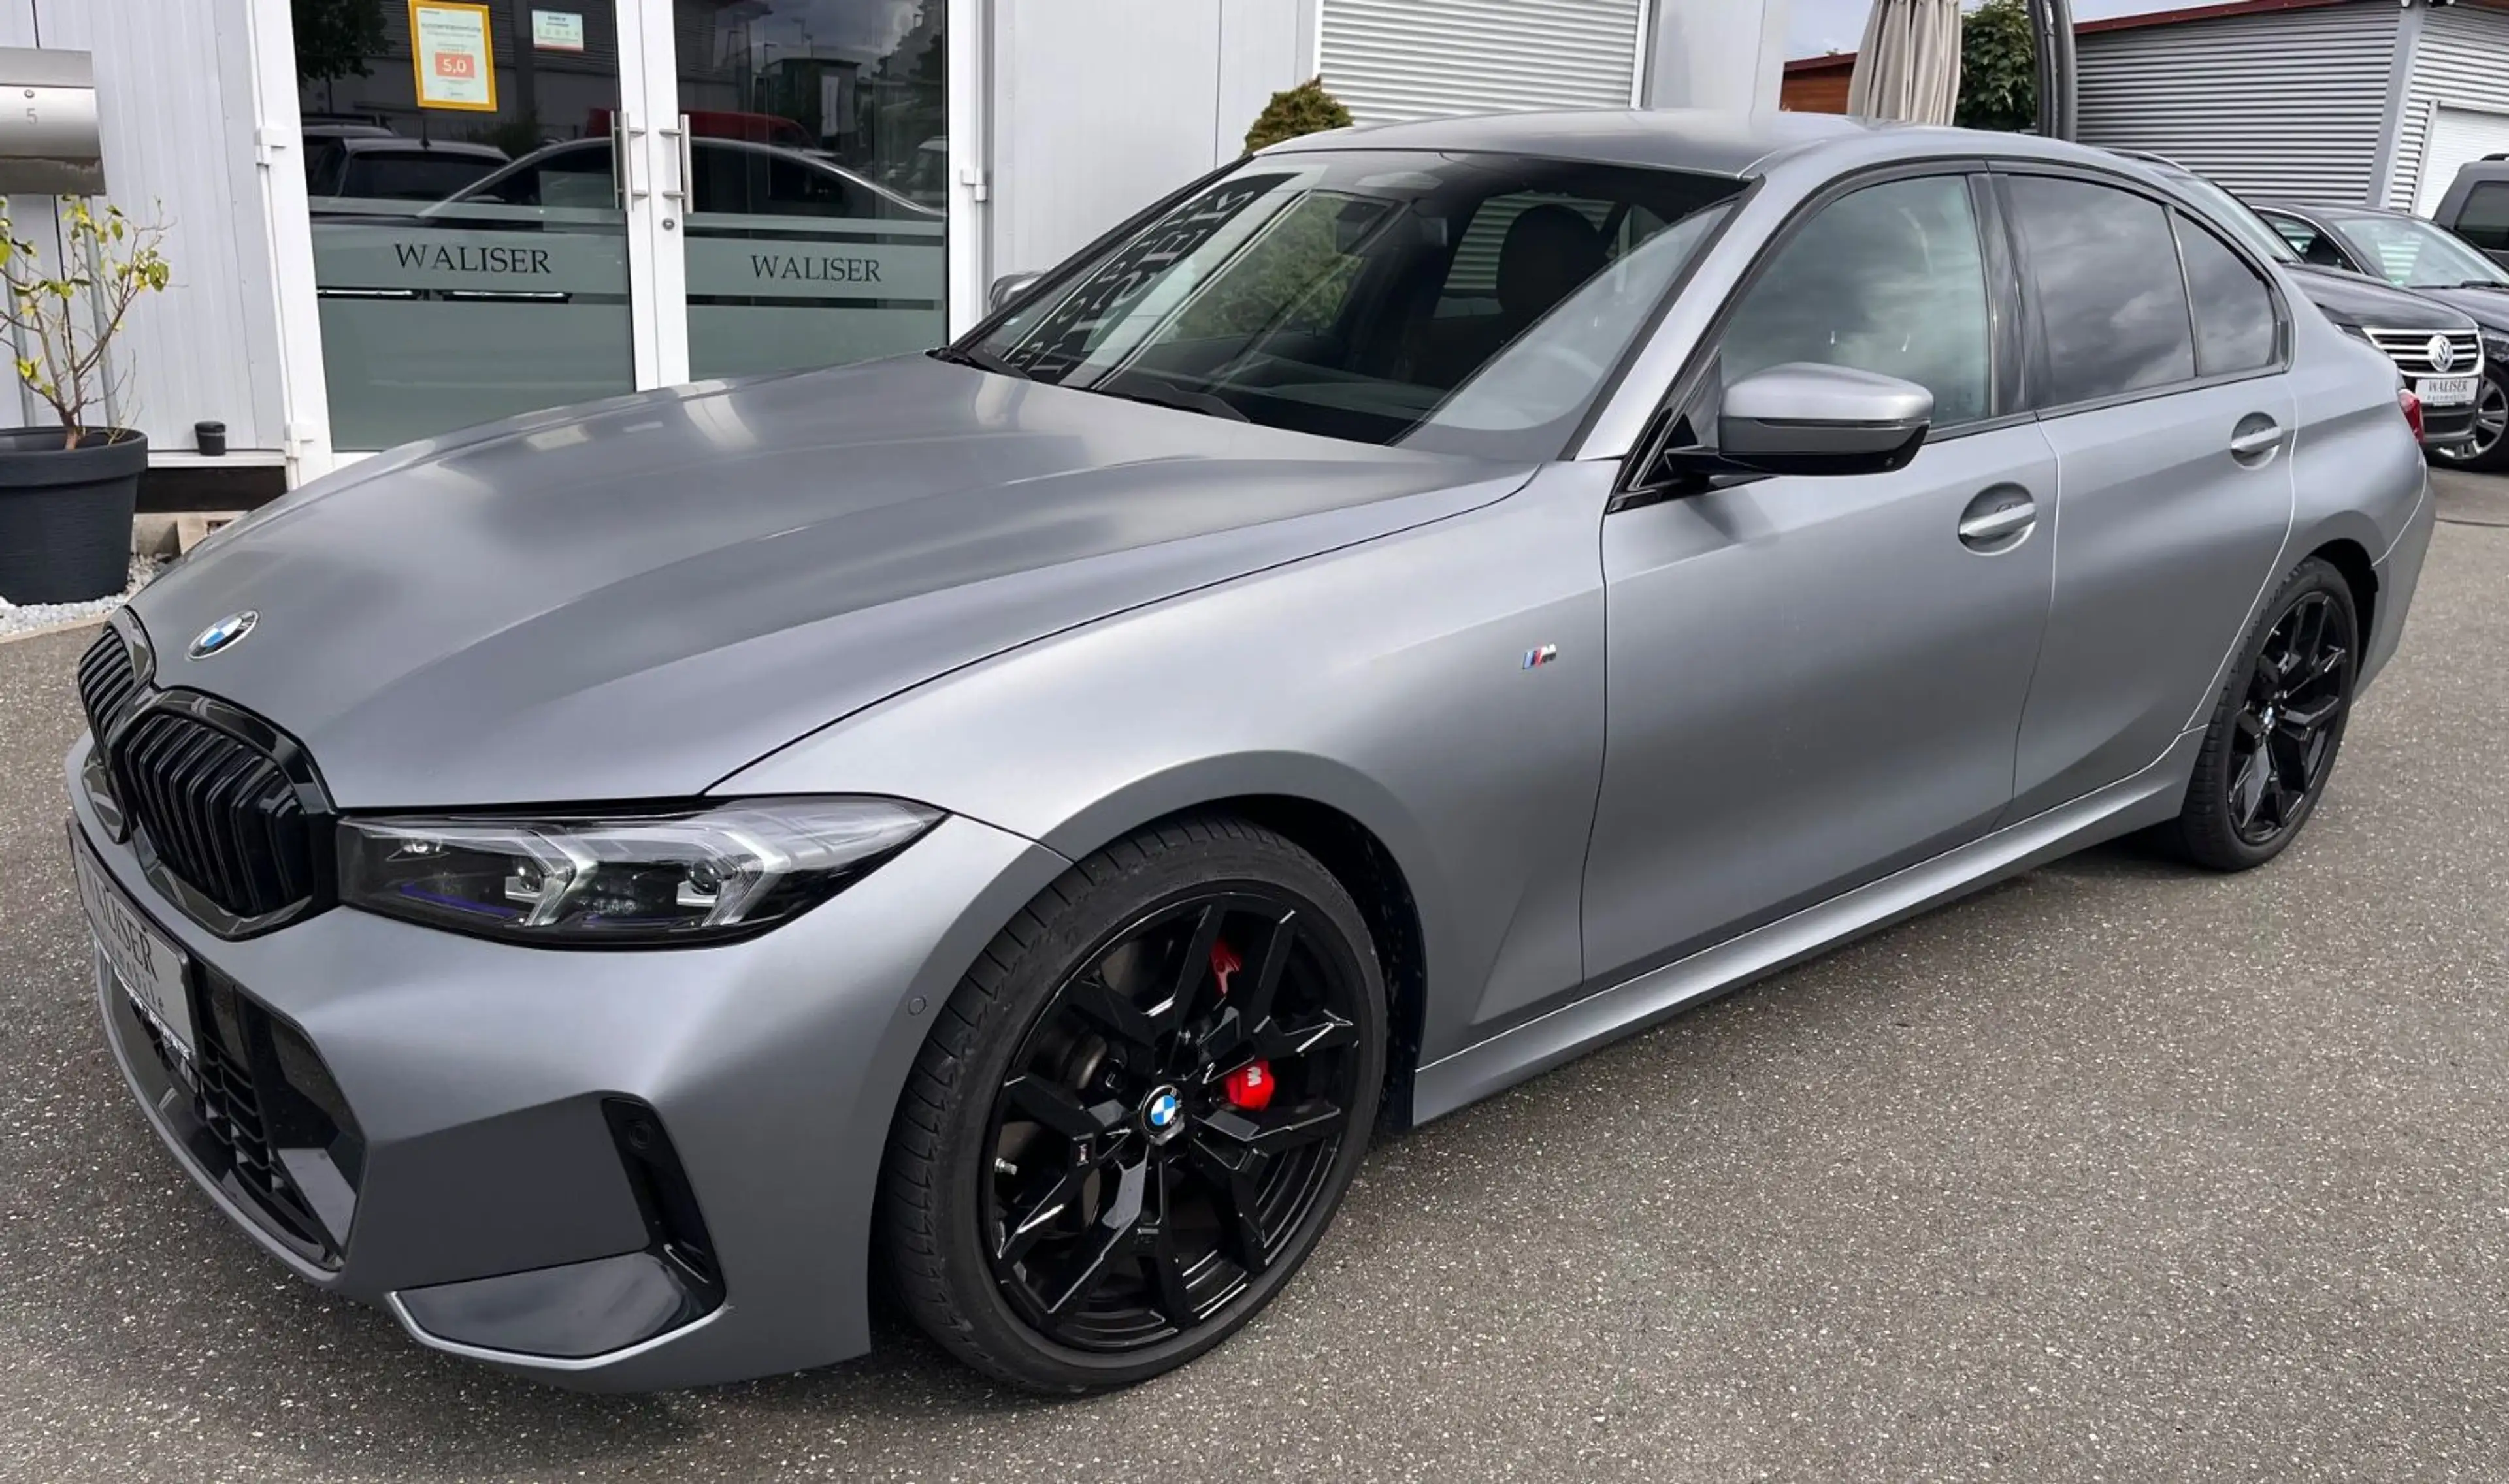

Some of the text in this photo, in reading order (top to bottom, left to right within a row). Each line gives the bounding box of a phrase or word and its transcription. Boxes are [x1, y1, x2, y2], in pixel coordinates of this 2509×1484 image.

[26, 108, 39, 125] 5
[394, 242, 552, 274] WALISER
[750, 254, 882, 282] WALISER
